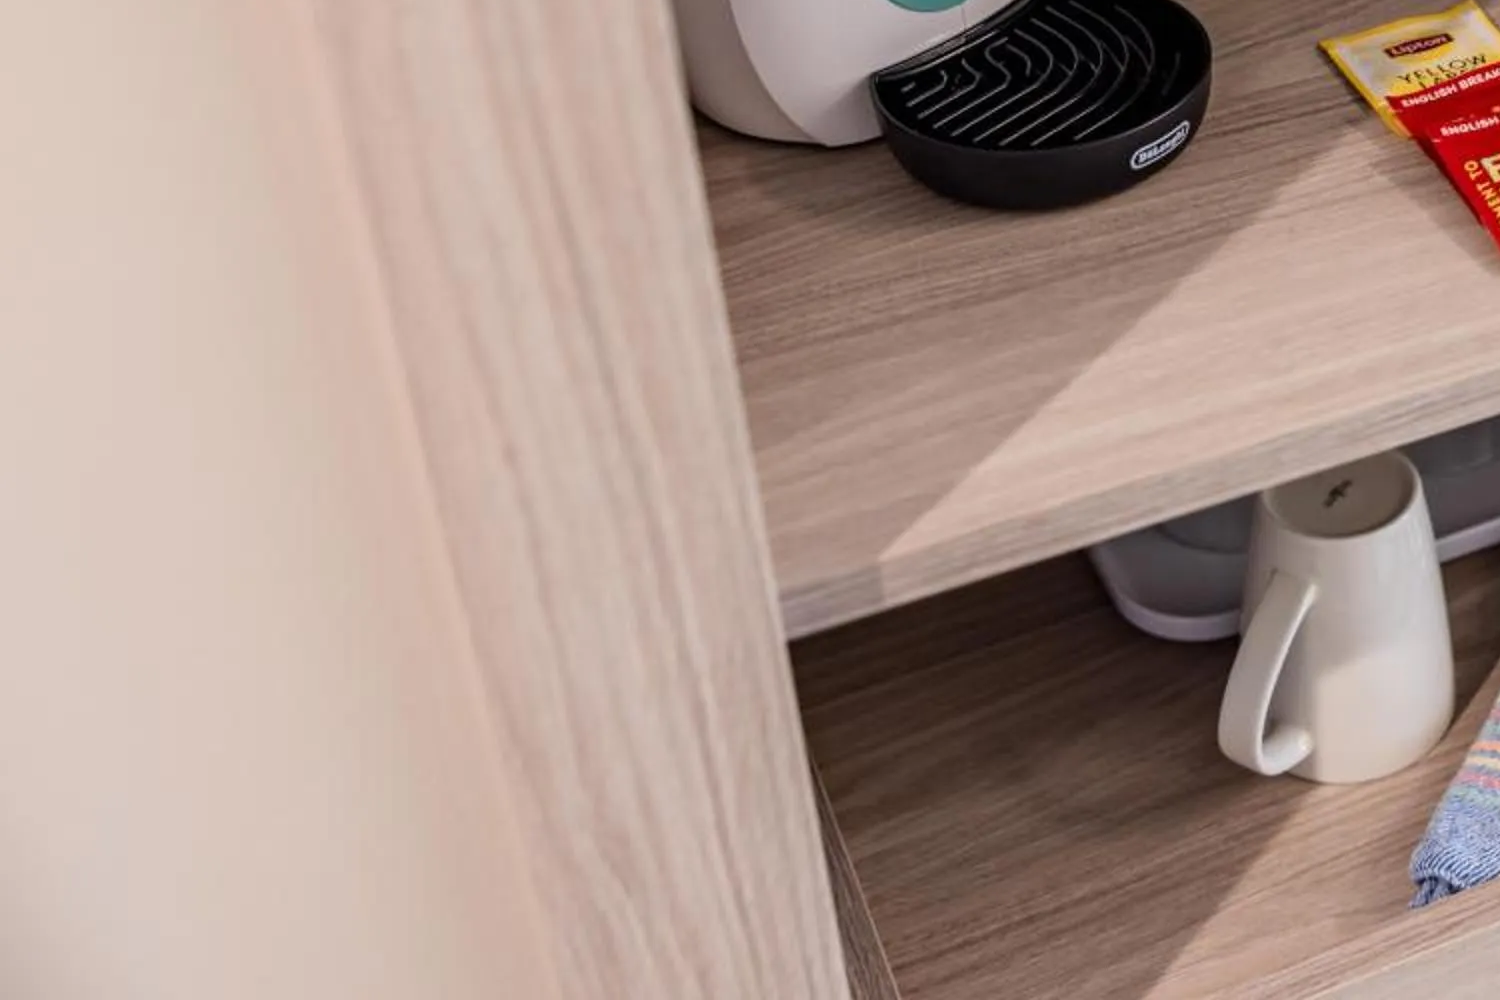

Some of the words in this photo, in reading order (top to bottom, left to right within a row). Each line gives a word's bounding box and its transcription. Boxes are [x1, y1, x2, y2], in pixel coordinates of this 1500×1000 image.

[1391, 35, 1447, 55] Lipton
[1397, 53, 1487, 84] YELLOW
[1401, 83, 1459, 108] ENGLISH
[1440, 115, 1500, 137] ENGLISH
[1464, 160, 1483, 181] TO
